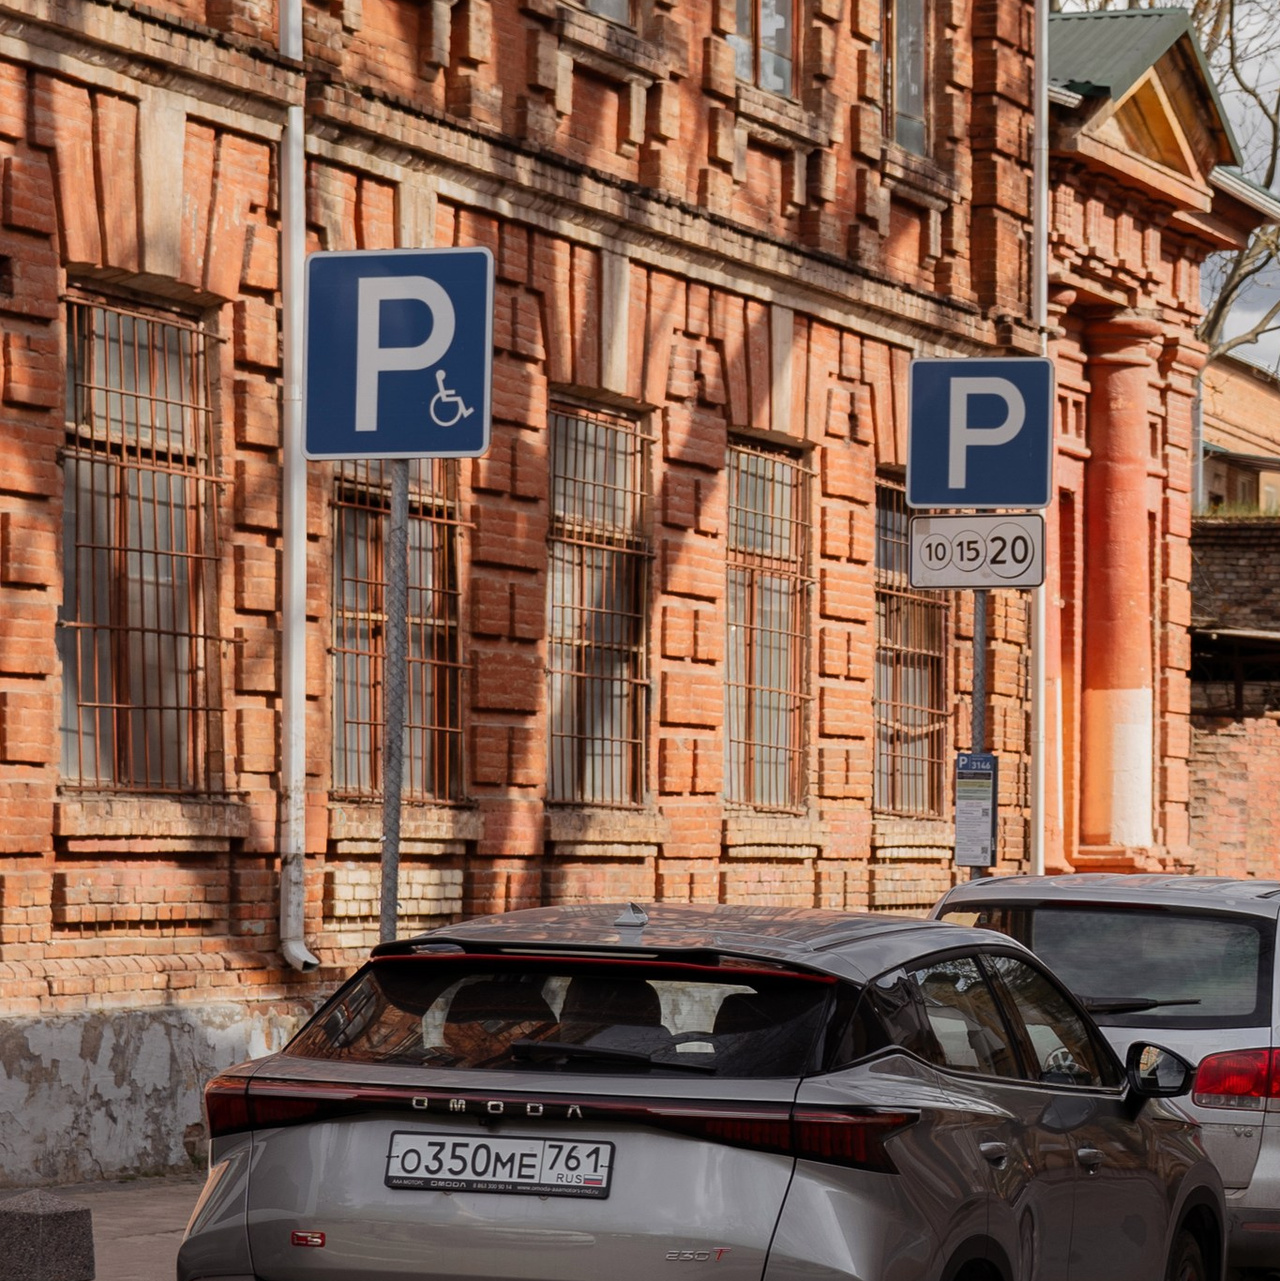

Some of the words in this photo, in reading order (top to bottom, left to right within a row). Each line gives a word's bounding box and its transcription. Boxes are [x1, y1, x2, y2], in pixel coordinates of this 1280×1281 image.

[354, 275, 456, 432] P
[948, 376, 1026, 489] P
[925, 542, 946, 562] 10
[956, 540, 980, 562] 15
[990, 535, 1029, 565] 20
[958, 756, 968, 769] P
[548, 1144, 601, 1173] 761
[556, 1173, 583, 1184] RUS
